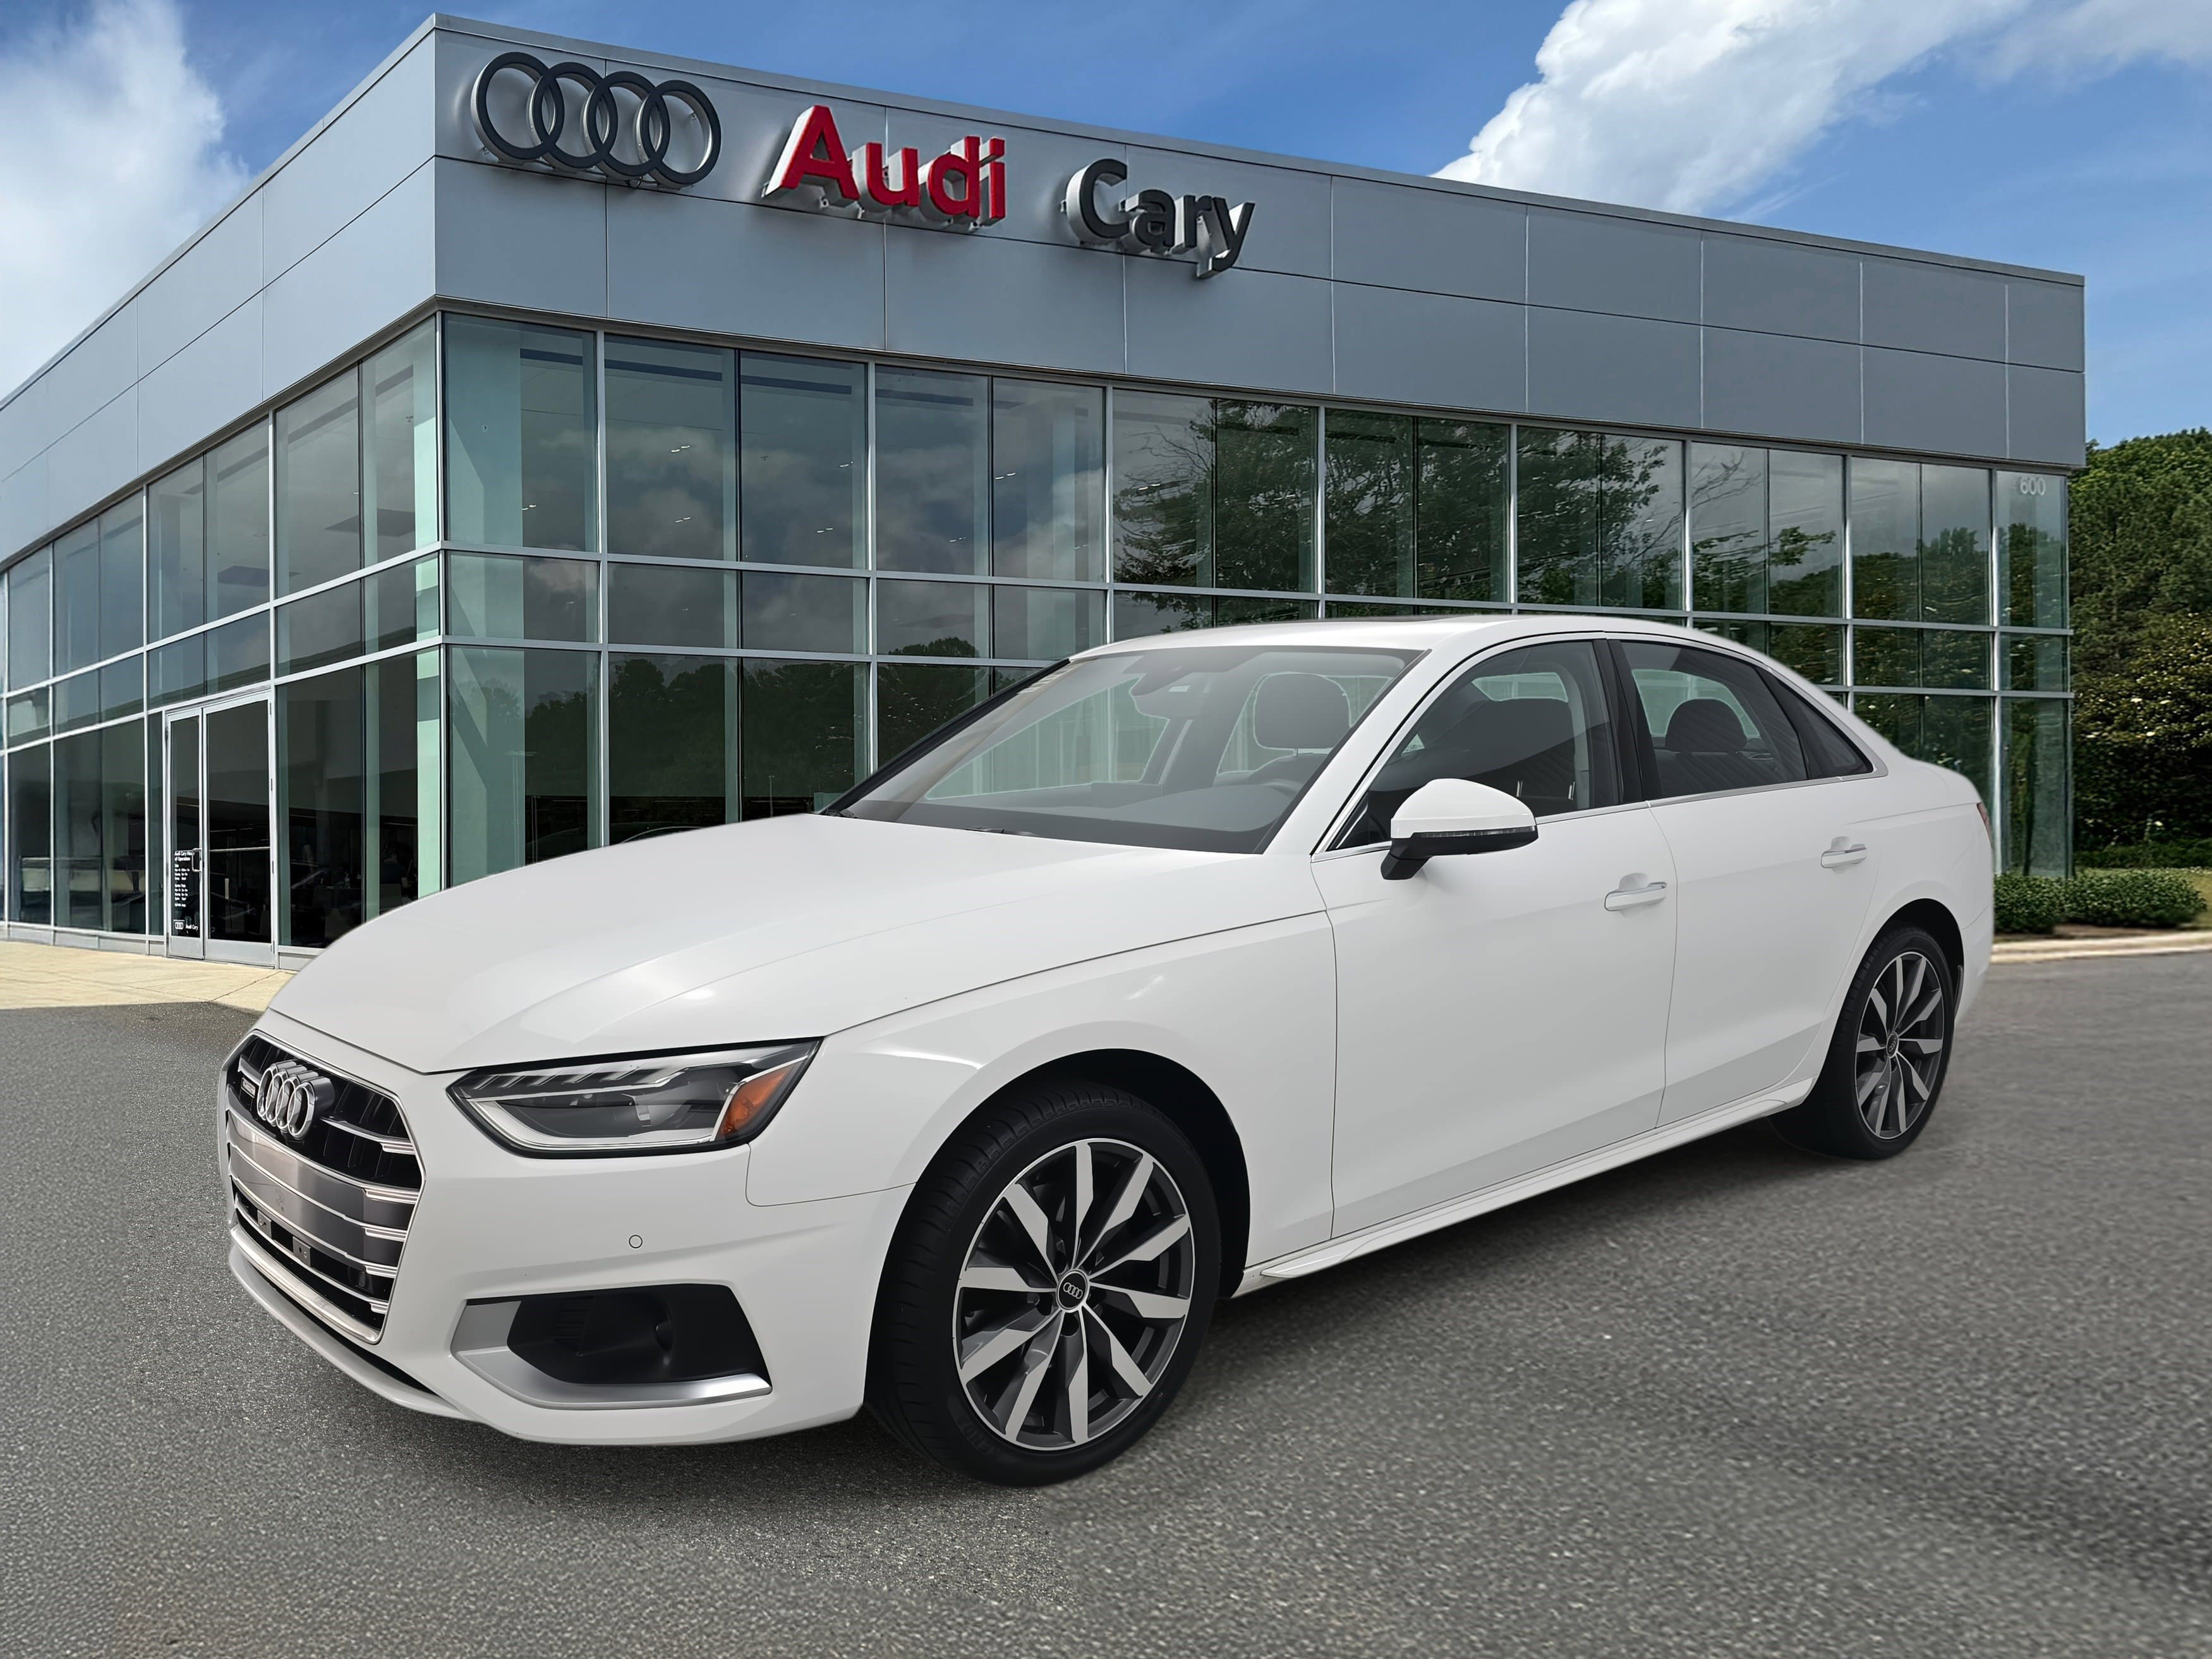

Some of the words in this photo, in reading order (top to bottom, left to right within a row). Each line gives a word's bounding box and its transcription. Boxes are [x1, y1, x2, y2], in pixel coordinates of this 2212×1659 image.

[767, 104, 1006, 222] Audi
[1067, 158, 1255, 276] Cary
[2020, 477, 2046, 495] 600
